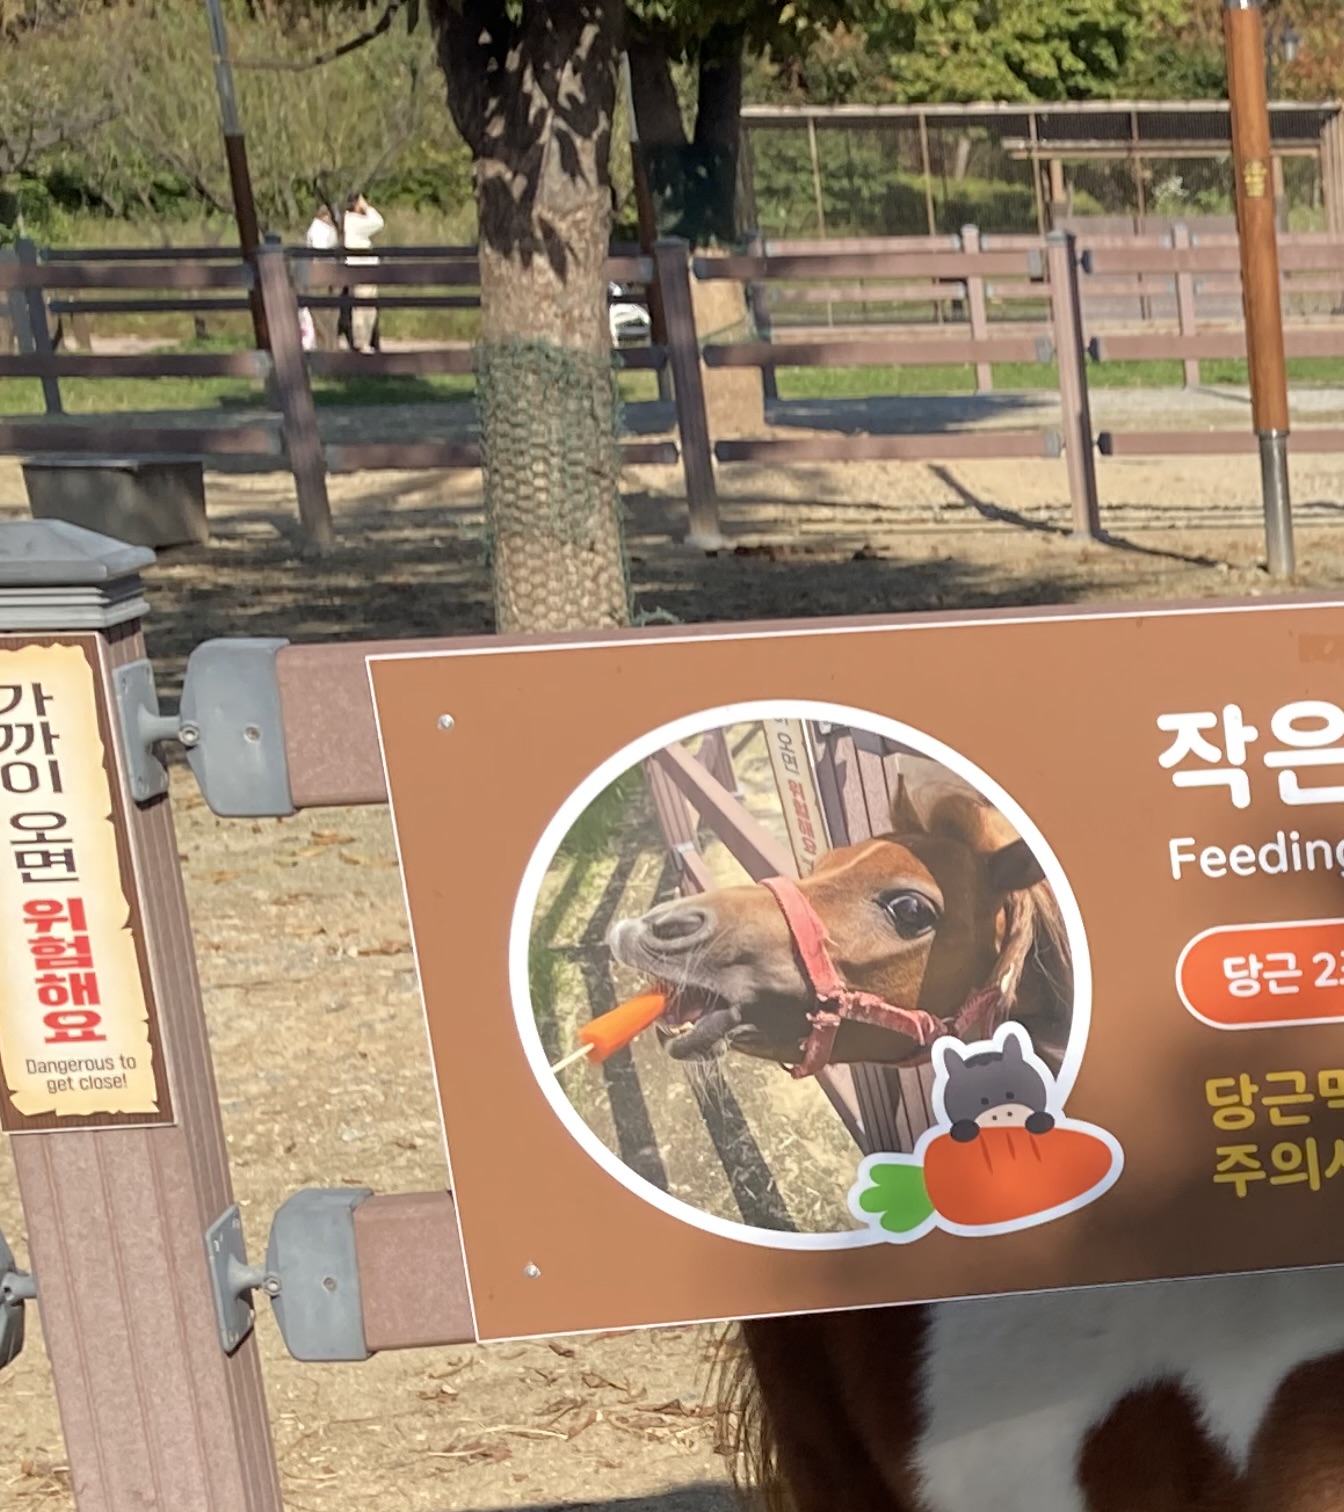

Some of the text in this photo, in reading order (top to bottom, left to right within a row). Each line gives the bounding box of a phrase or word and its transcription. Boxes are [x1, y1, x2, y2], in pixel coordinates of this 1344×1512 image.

[0, 682, 107, 1044] 가까이 오면 위험해요
[1223, 951, 1303, 998] 당근
[25, 1053, 137, 1076] Dangerous to
[46, 1073, 129, 1094] get close!
